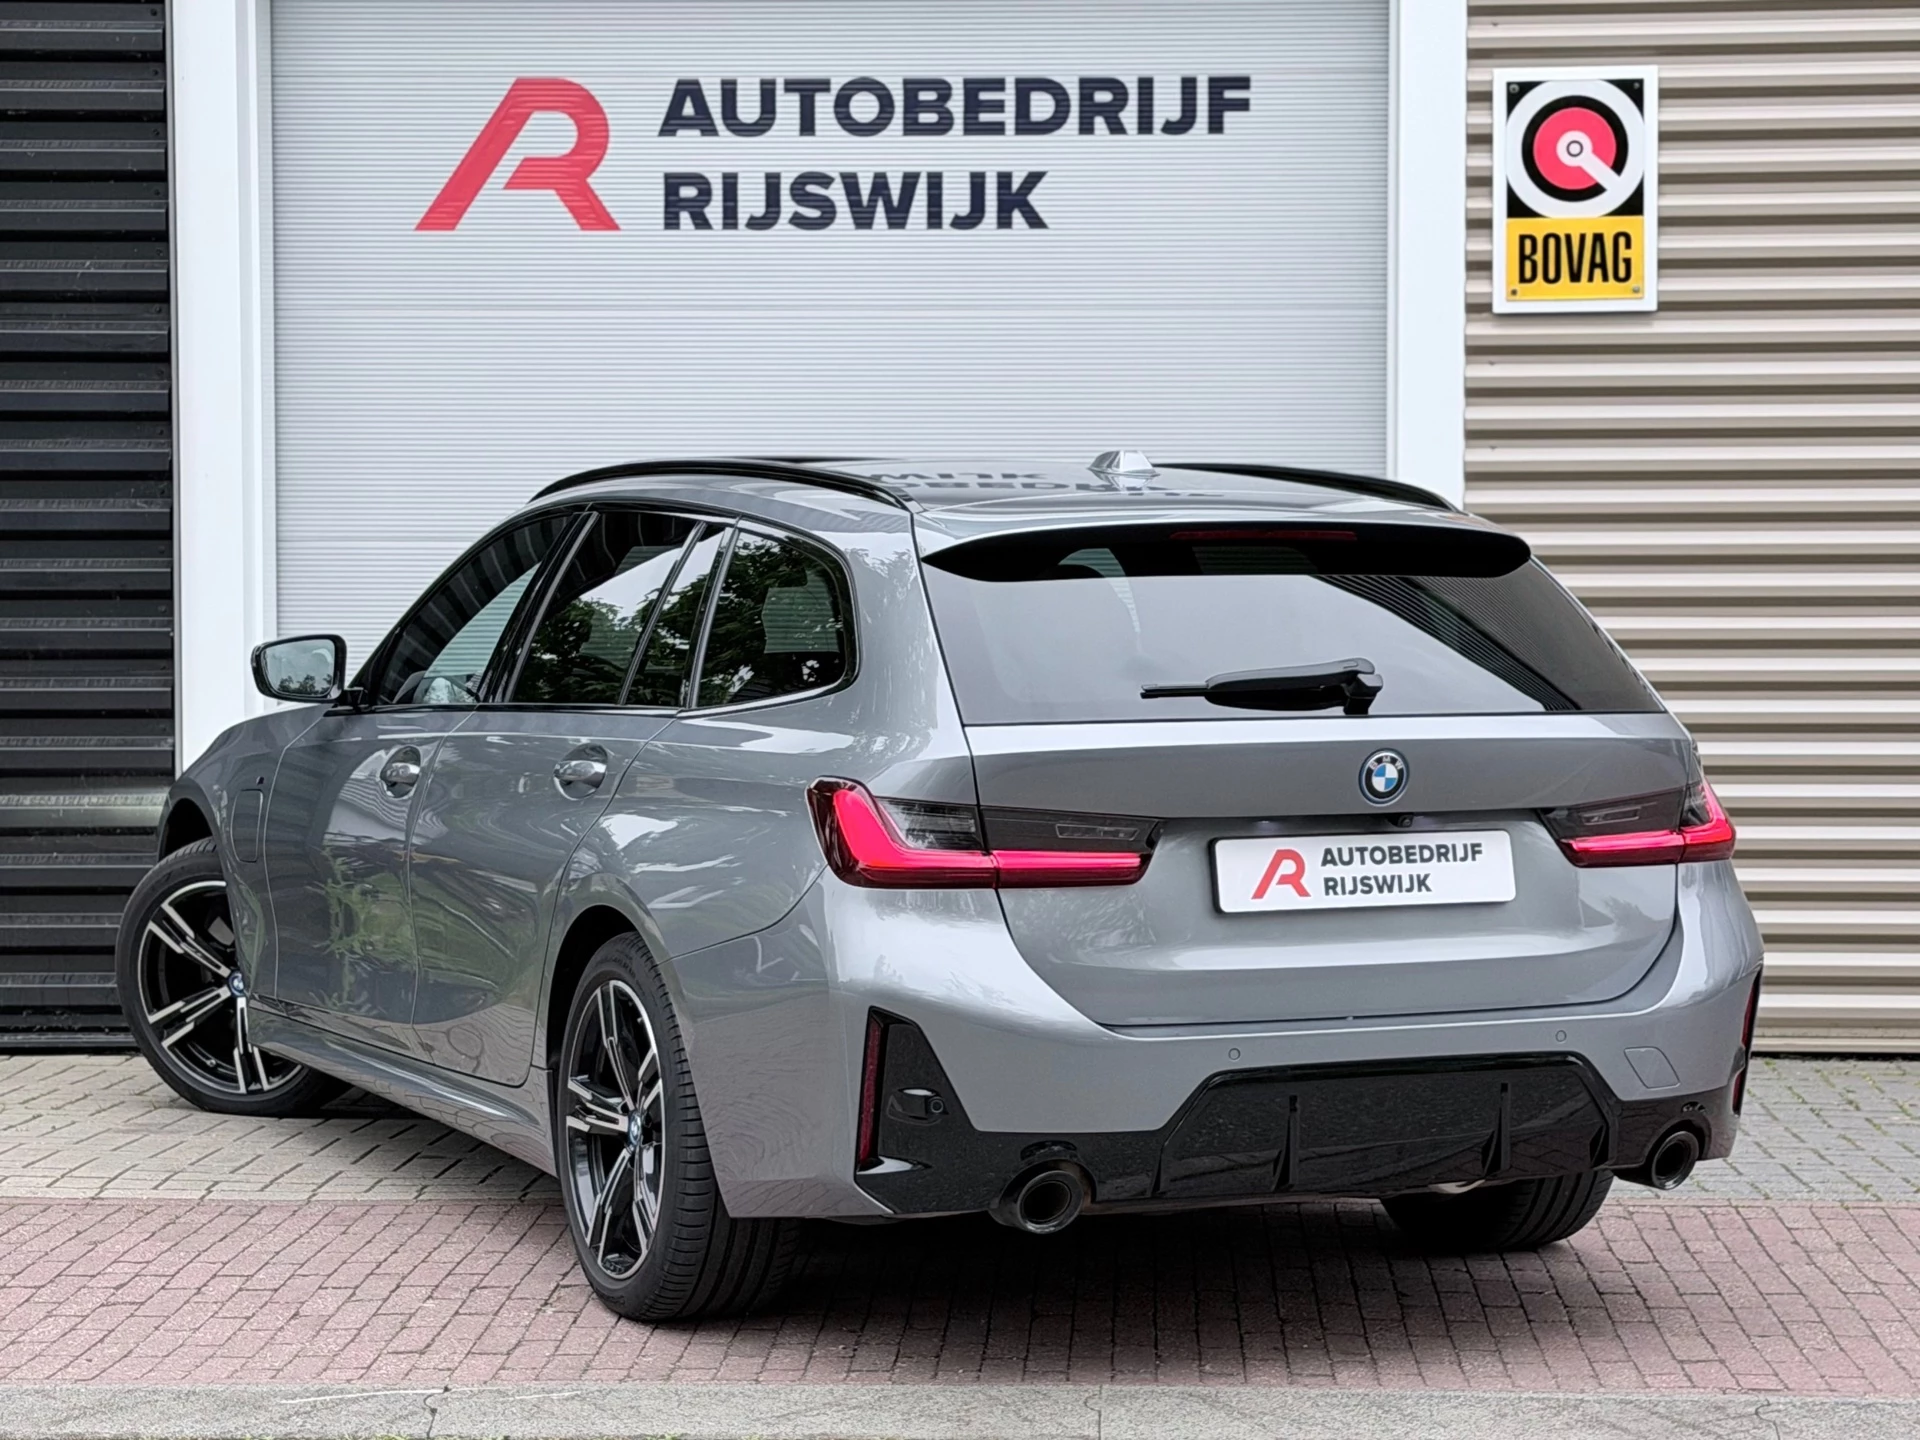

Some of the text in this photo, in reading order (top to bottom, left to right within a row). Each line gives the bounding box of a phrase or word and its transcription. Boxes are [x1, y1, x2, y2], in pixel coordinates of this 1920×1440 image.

[658, 75, 1251, 138] AUTOBEDRIJF
[663, 171, 1049, 231] RIJSWIJK
[1518, 231, 1633, 284] BOVAG
[1369, 755, 1404, 770] BMW
[1320, 843, 1483, 867] AUTOBEDRIJF
[1323, 873, 1432, 896] RIJSWIJK
